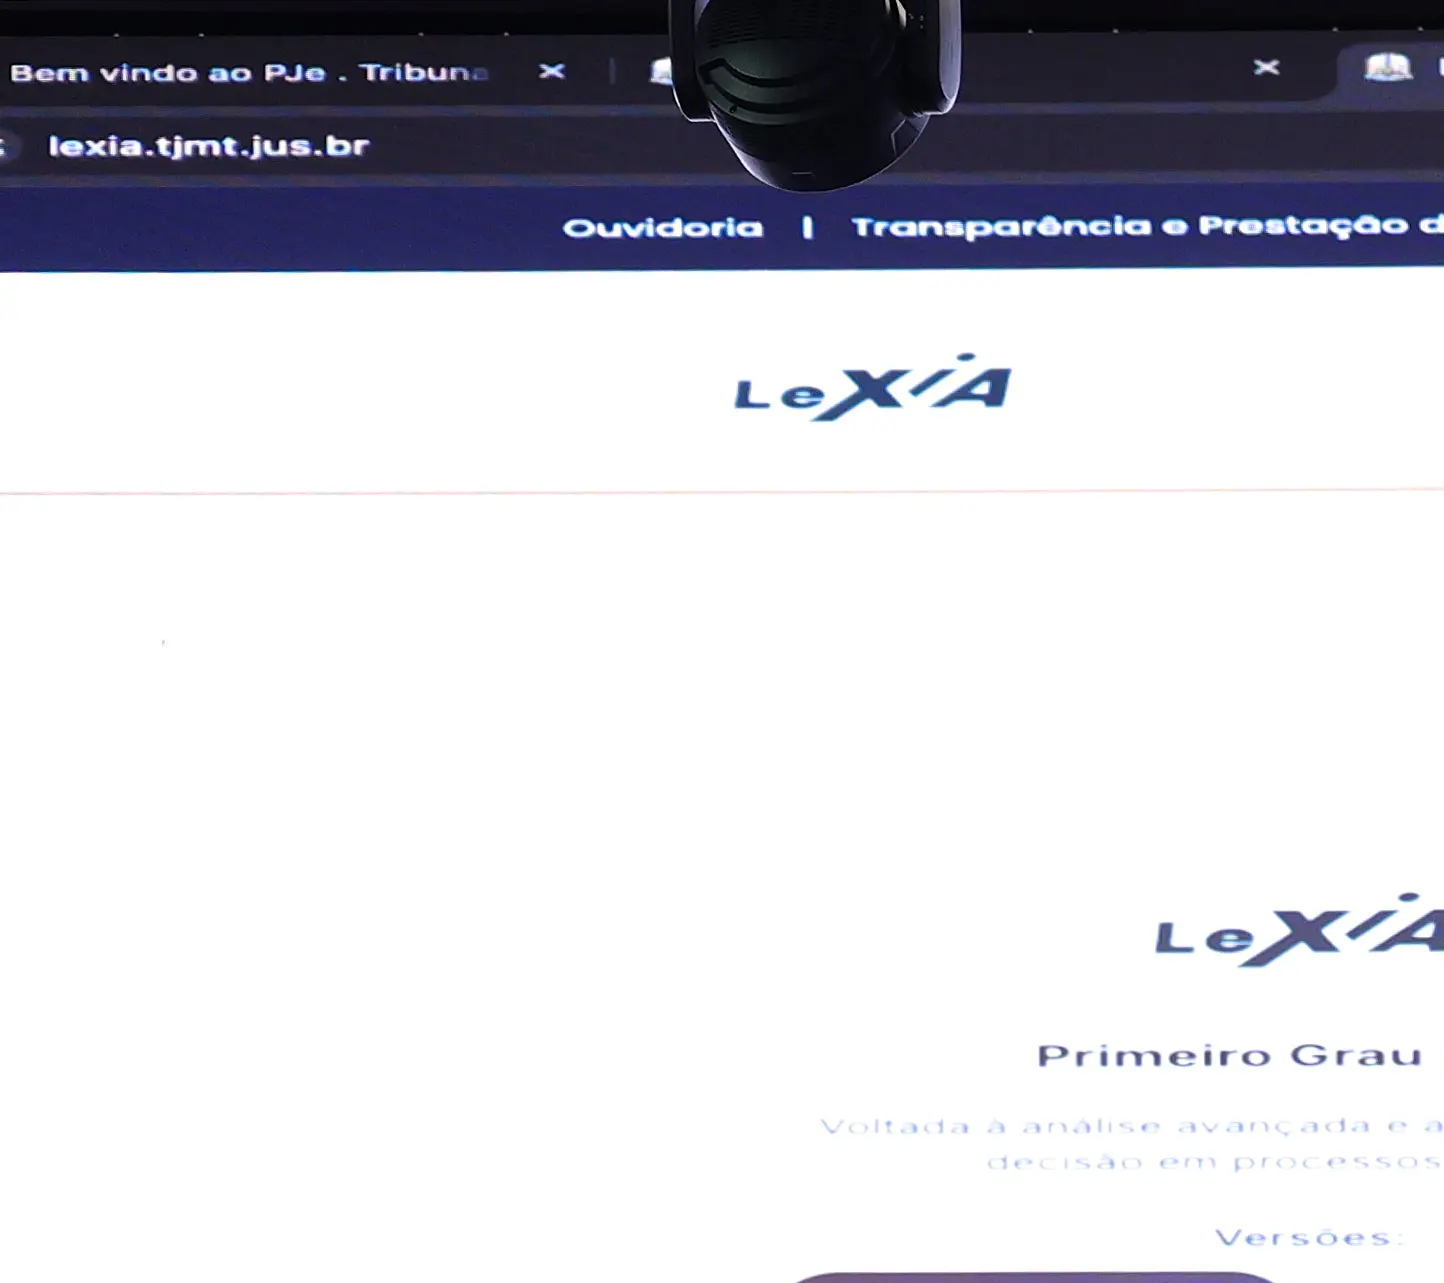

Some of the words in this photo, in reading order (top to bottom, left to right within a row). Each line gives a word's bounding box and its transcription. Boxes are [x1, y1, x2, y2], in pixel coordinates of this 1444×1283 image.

[11, 65, 90, 82] Bem
[100, 63, 198, 82] vindo
[208, 68, 252, 82] ao
[265, 64, 327, 82] PJe
[50, 135, 370, 160] lexia.tjmt.jus.br
[563, 217, 764, 238] Ouvidoria
[851, 215, 1152, 242] Transparência
[1161, 219, 1190, 235] e
[1199, 215, 1409, 240] Prestação
[1039, 1044, 1270, 1067] Primeiro
[1291, 1044, 1421, 1066] Grau
[821, 1119, 969, 1134] Voltada
[1023, 1118, 1160, 1134] análise
[1179, 1118, 1369, 1137] avançada
[1388, 1121, 1407, 1132] e
[987, 1155, 1142, 1170] decisão
[1159, 1157, 1216, 1169] em
[1234, 1157, 1440, 1173] processos
